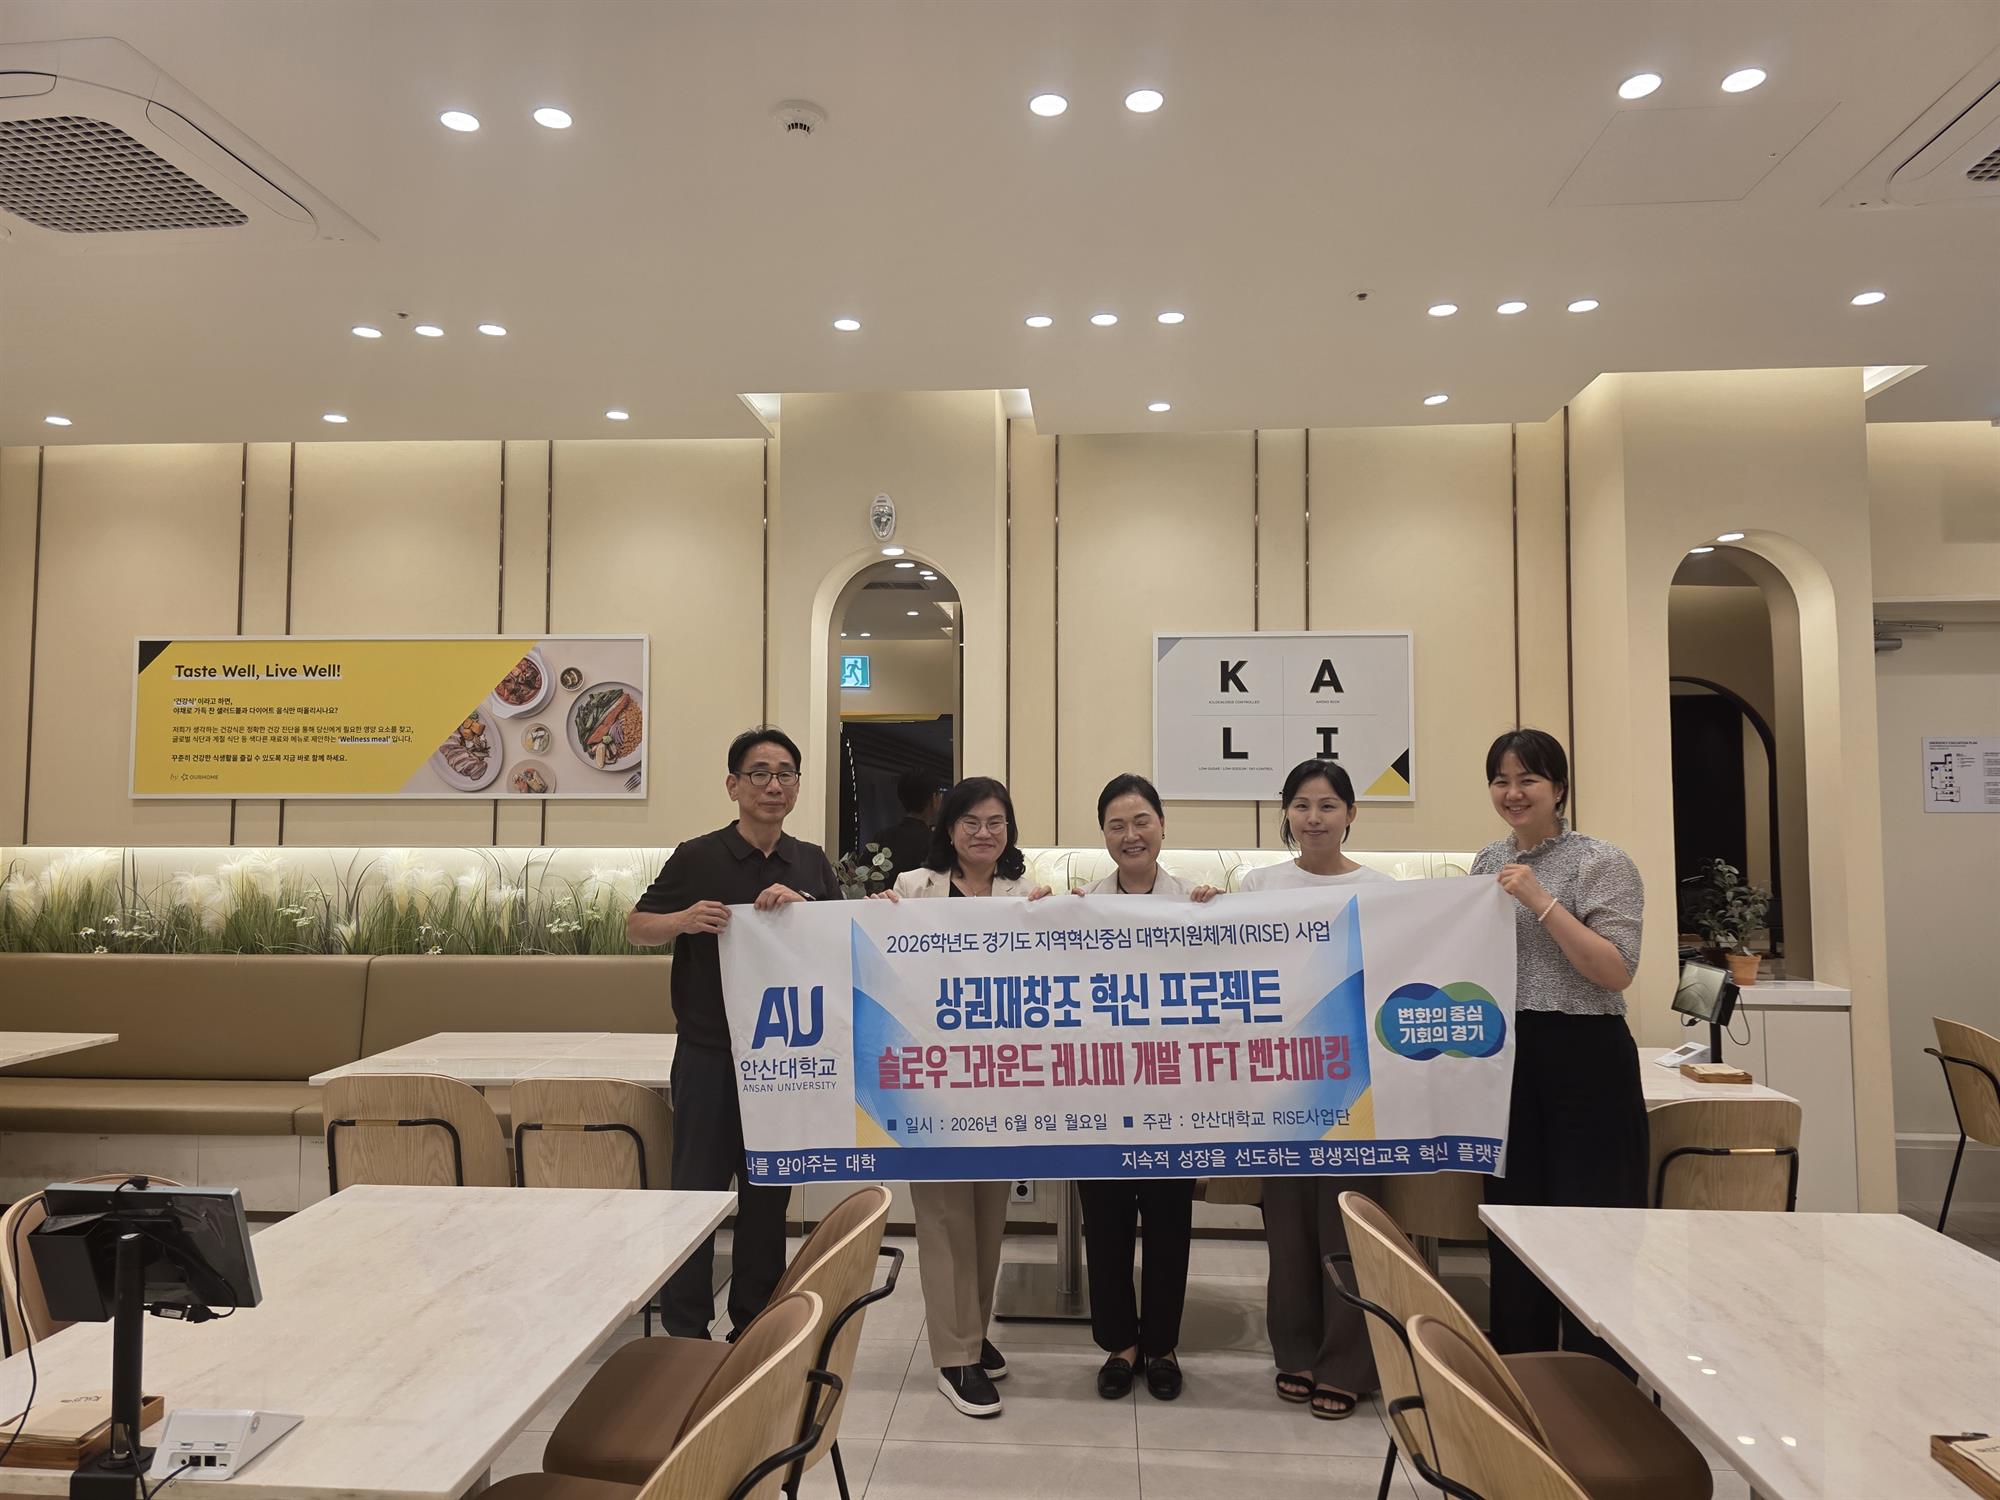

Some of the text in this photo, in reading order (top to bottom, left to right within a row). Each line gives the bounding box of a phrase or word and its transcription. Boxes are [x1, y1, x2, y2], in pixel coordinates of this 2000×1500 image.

[175, 664, 341, 680] Taste Well, Live Well!
[1220, 660, 1249, 693] K
[1310, 659, 1344, 693] A
[172, 735, 191, 743] 글로벌
[193, 735, 210, 743] 식단과
[212, 735, 225, 743] 계절
[227, 735, 240, 743] 식단
[241, 735, 247, 743] 등
[249, 735, 268, 743] 색다른
[290, 735, 309, 743] 메뉴로
[311, 735, 335, 743] 제안하는
[1222, 727, 1249, 760] L
[1316, 727, 1339, 760] I
[171, 754, 191, 762] 꾸준히
[192, 754, 211, 762] 건강한
[213, 754, 238, 762] 식생활을
[240, 754, 253, 762] 즐길
[254, 754, 261, 762] 수
[262, 754, 281, 762] 있도록
[283, 754, 296, 762] 지금
[297, 754, 310, 762] 바로
[312, 754, 325, 762] 함께
[887, 920, 1330, 953] 2026학년도 경기도 지역혁신중심 대학지원체계(RISE) 사업
[935, 969, 1283, 1031] 상권재창조 혁신 프로젝트
[751, 985, 824, 1050] AU
[1397, 1004, 1483, 1025] 변화의 중심
[1399, 1024, 1484, 1044] 기회의 경기
[740, 1056, 838, 1081] 안산대학교
[878, 1035, 1351, 1089] 슬로우그라운드 레시피 개발 TFT 벤치마킹
[743, 1081, 837, 1093] ANSAN UNIVERSITY
[905, 1116, 933, 1134] 일시
[951, 1115, 998, 1133] 2026년
[1004, 1114, 1027, 1132] 6월
[1034, 1113, 1057, 1132] 8일
[1064, 1113, 1108, 1131] 월요일
[1142, 1112, 1172, 1130] 주관
[1191, 1109, 1266, 1129] 안산대학교
[1273, 1107, 1351, 1127] RISE사업단
[776, 1154, 838, 1176] 알아주는
[845, 1153, 877, 1173] 대학
[1121, 1150, 1170, 1170] 지속적
[1177, 1148, 1227, 1169] 성장을
[1234, 1147, 1301, 1168] 선도하는
[1309, 1145, 1411, 1167] 평생직업교육
[1418, 1142, 1449, 1164] 혁신
